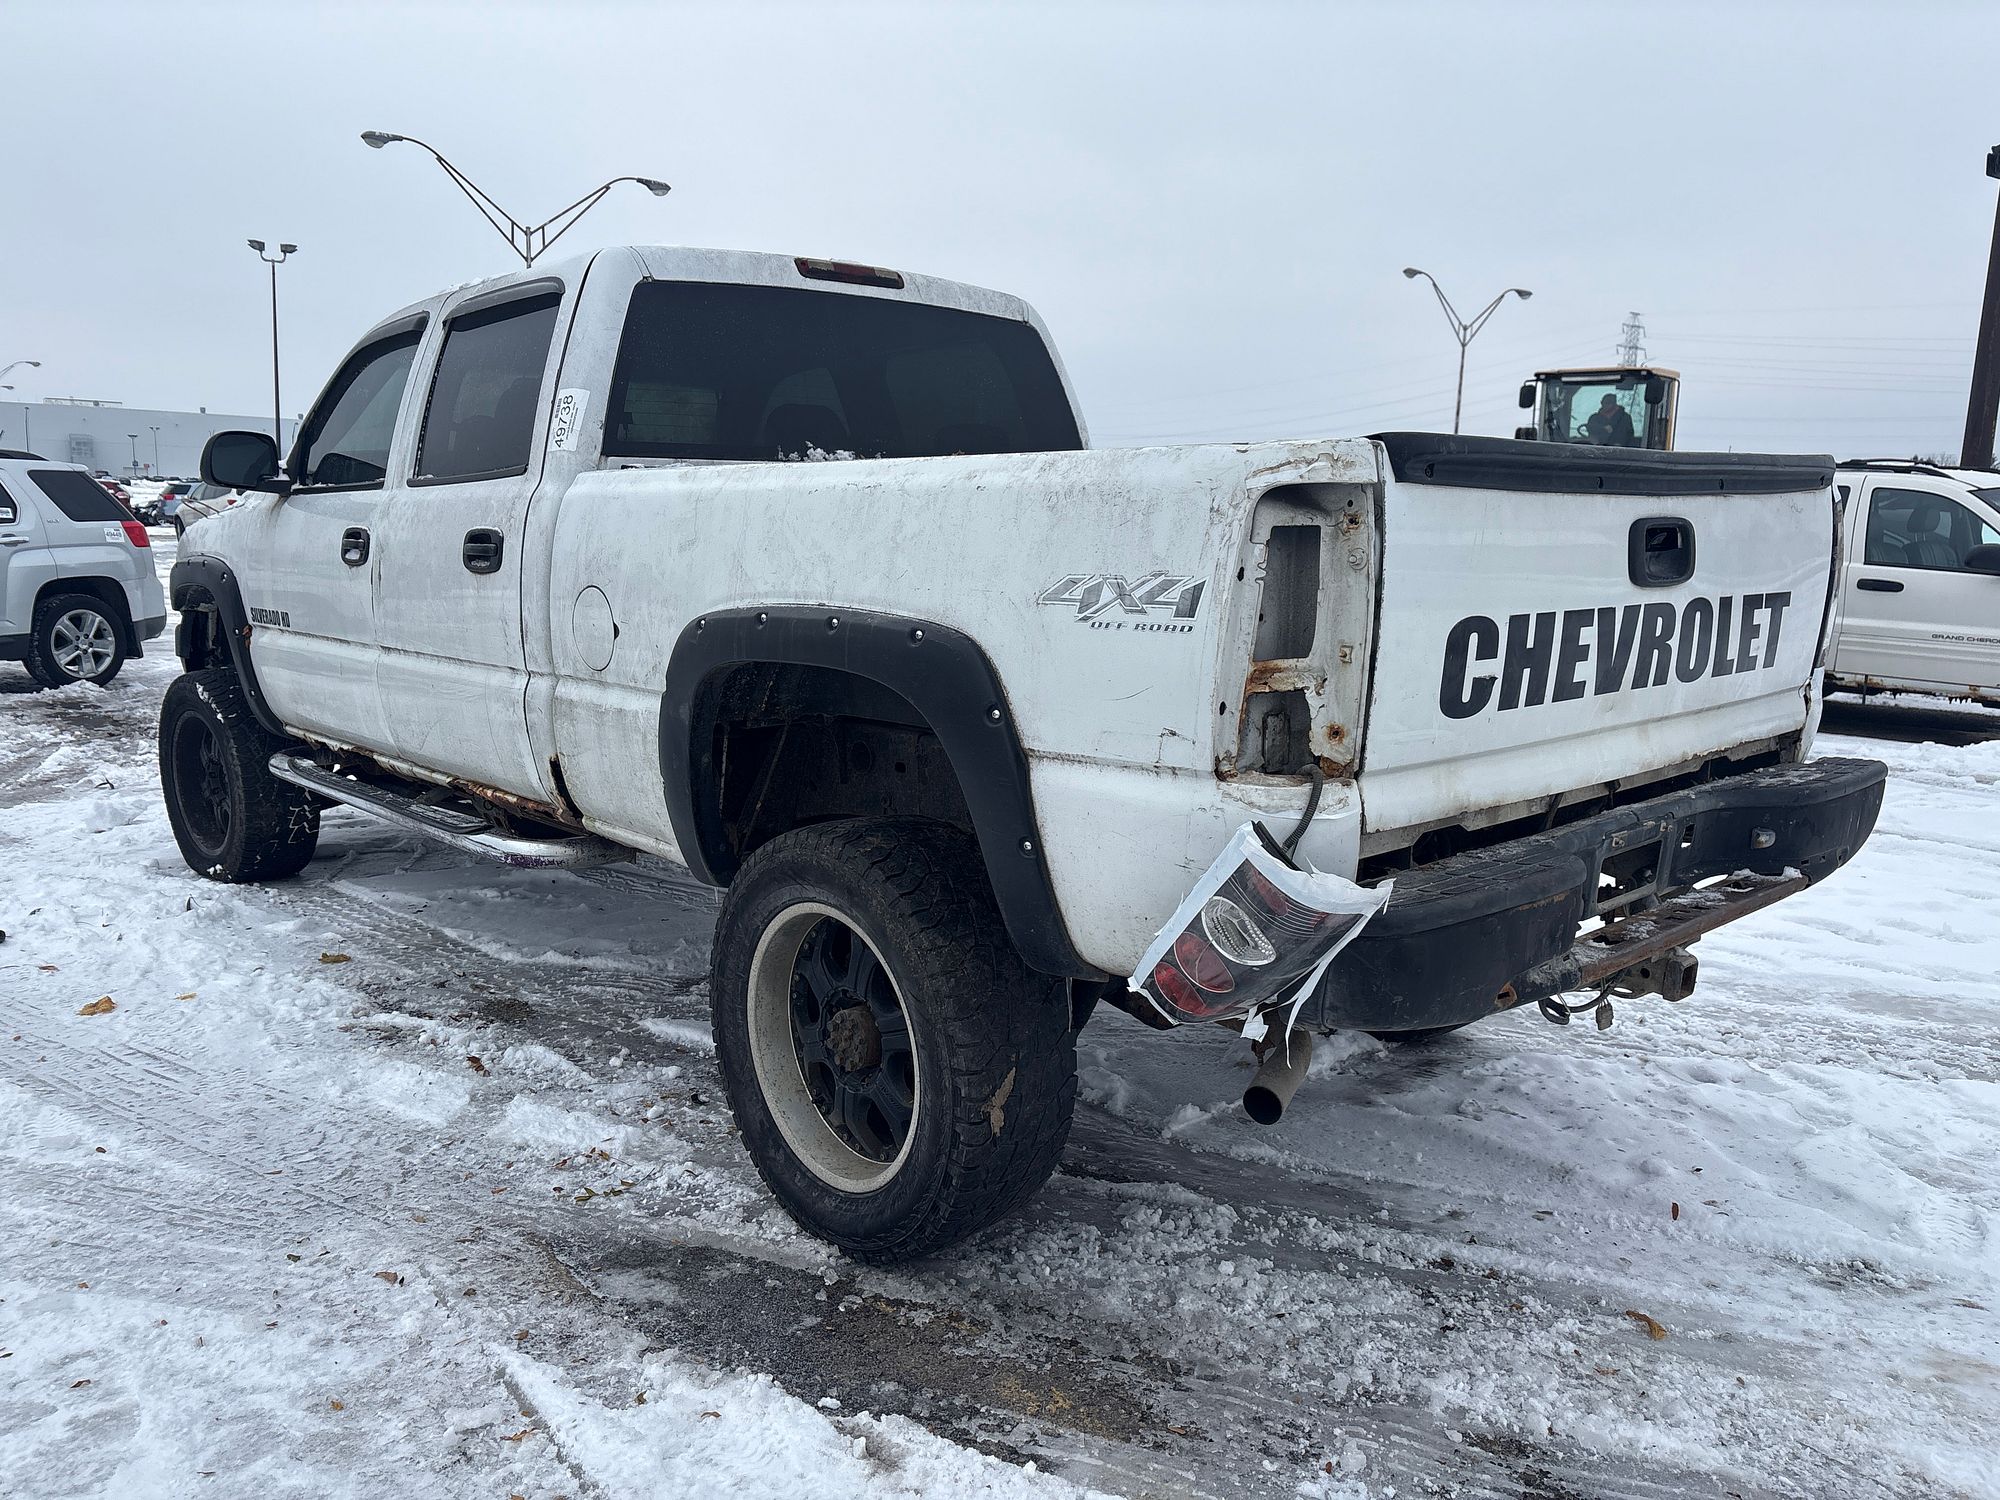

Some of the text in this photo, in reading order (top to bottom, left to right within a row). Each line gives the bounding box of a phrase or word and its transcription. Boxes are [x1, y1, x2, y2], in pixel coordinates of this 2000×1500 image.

[555, 394, 574, 448] 49738
[250, 606, 291, 628] SILVERADO HD
[1090, 620, 1195, 633] OFF ROAD
[1931, 633, 1965, 641] GRAND
[1439, 591, 1792, 719] CHEVROLET
